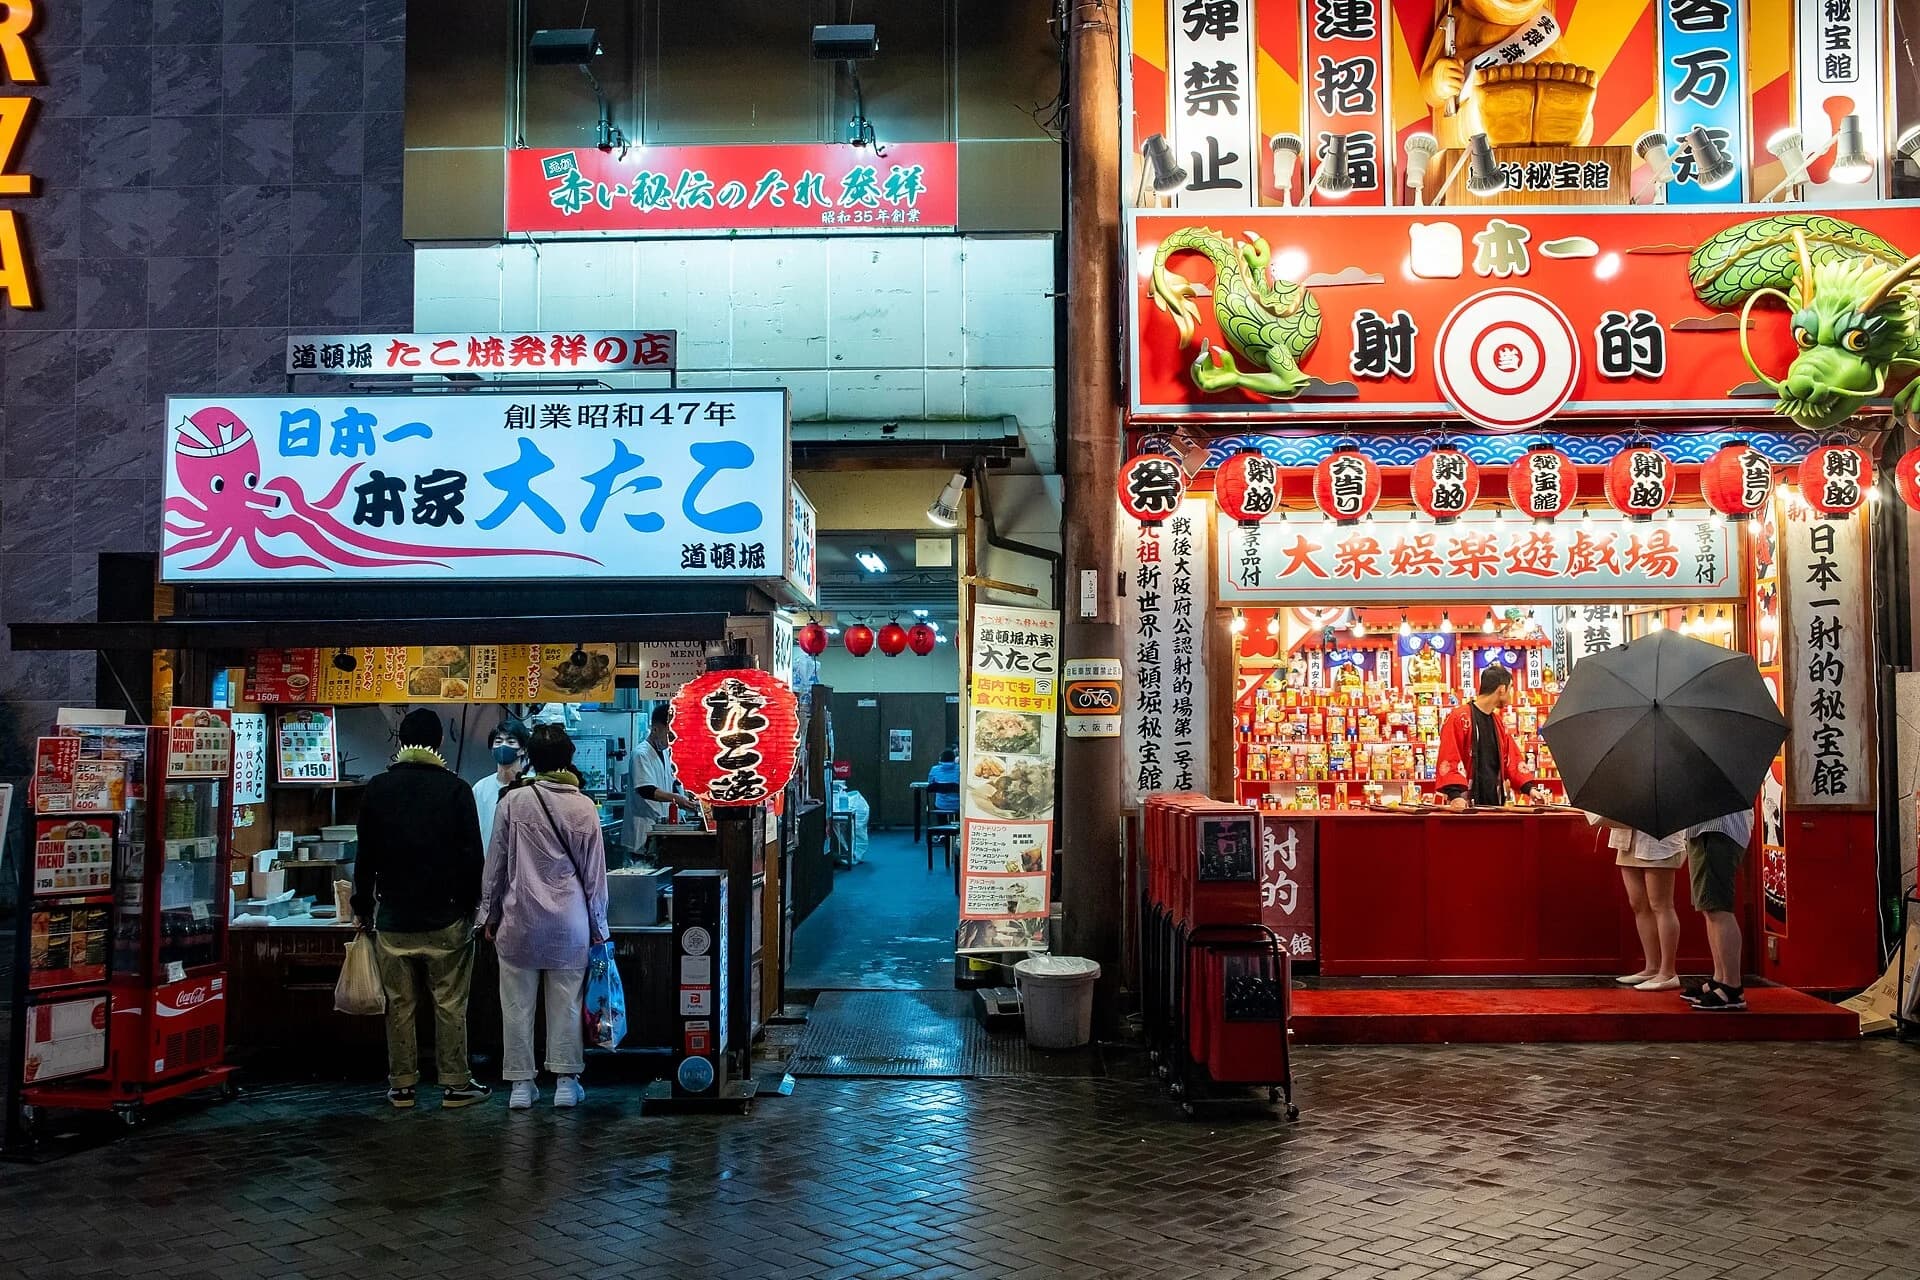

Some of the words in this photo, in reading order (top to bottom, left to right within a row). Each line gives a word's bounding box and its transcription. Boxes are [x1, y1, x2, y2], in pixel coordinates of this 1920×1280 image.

[1825, 0, 1852, 79] 秘宝館
[1469, 162, 1609, 190] 的秘宝館
[822, 209, 920, 224] 昭和35年創業
[292, 342, 372, 369] 道頓堀
[385, 332, 672, 368] たこ焼発祥の店
[503, 401, 737, 429] 創業昭和47年
[278, 407, 433, 457] 日本一
[352, 468, 468, 528] 本家
[475, 437, 763, 534] 大たこ
[1129, 459, 1182, 511] 祭
[1244, 457, 1276, 512] 射的
[1433, 454, 1466, 509] 射的
[1531, 453, 1560, 511] 秘宝館
[1632, 452, 1663, 508] 射的
[1826, 450, 1860, 506] 射的
[681, 542, 766, 570] 道頓堀
[1277, 529, 1681, 582] 大衆娯楽遊戯場
[1694, 522, 1717, 585] 景品付
[670, 650, 702, 658] MENU
[980, 628, 1054, 648] 道頓堀本家
[1171, 517, 1192, 792] 戦後大阪府公認射的場第一号店
[979, 644, 1054, 673] 大たこ
[1806, 522, 1849, 797] 日本一射的秘宝館
[978, 677, 1031, 692] 店内でも
[173, 728, 195, 740] DRINK
[1078, 723, 1113, 733] 大阪市
[172, 740, 194, 754] MENU
[298, 763, 327, 777] ¥150
[37, 841, 65, 855] DRINK
[37, 854, 65, 869] MENU
